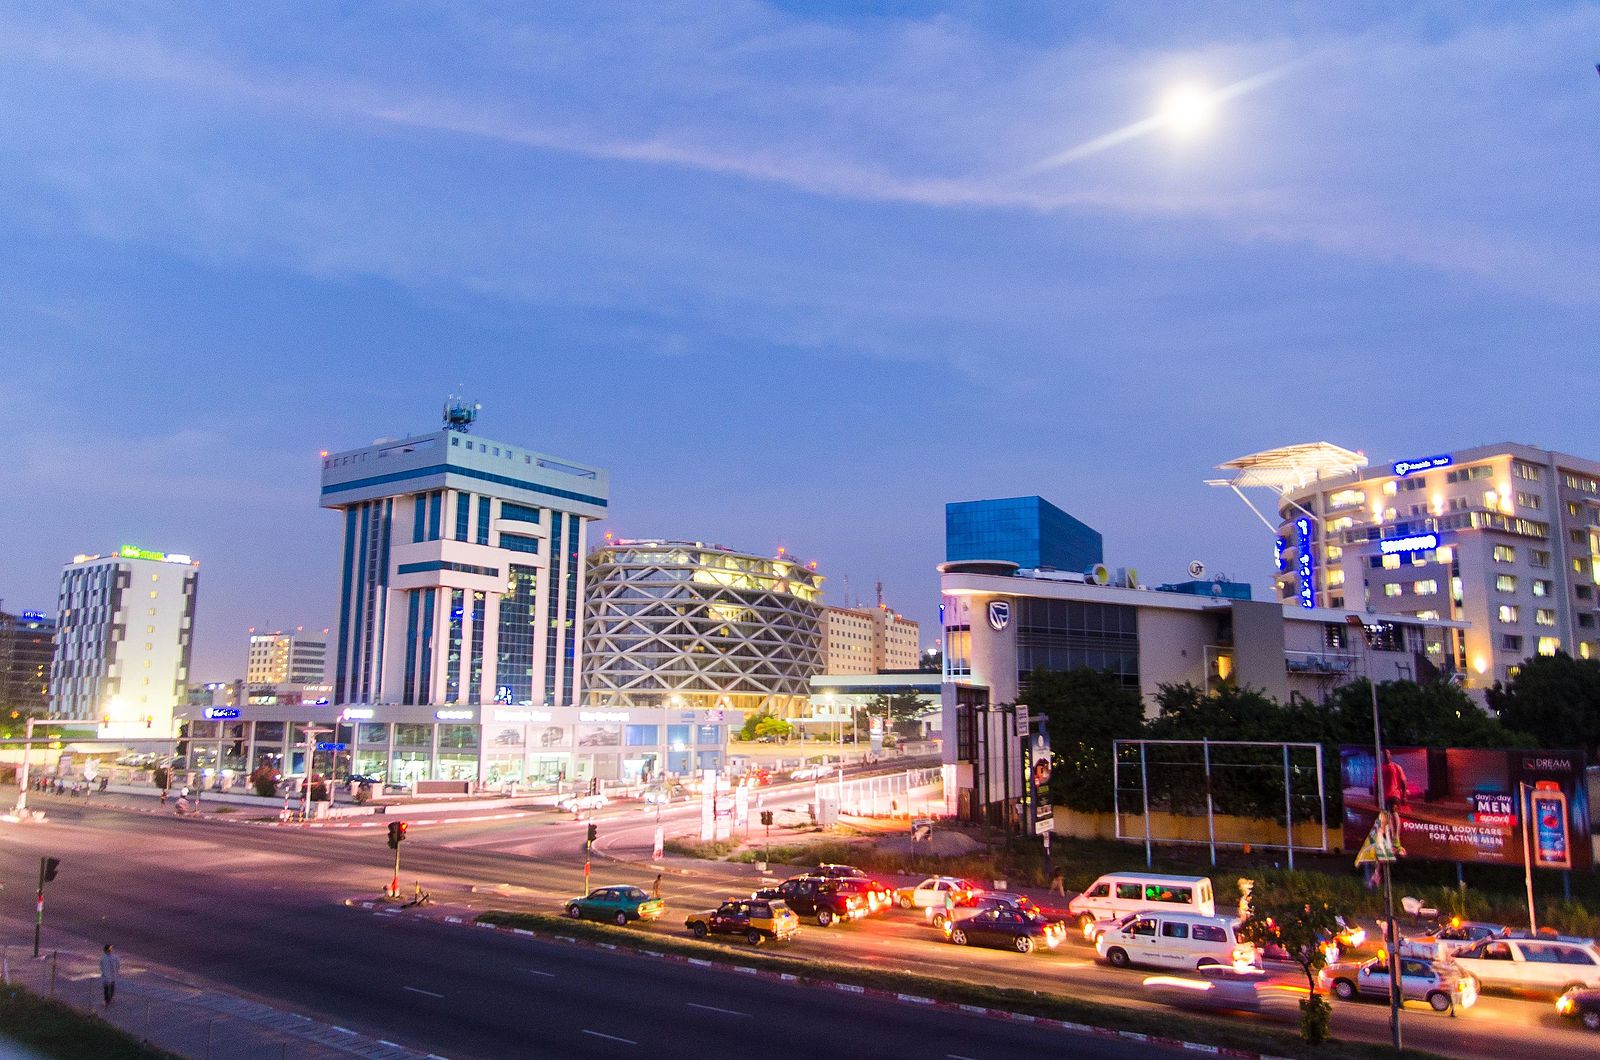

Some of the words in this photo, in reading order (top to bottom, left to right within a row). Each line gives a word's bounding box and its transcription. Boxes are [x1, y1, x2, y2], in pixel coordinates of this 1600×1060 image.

[1536, 758, 1570, 767] DREAM
[1478, 802, 1511, 813] MEN
[1479, 814, 1509, 824] sport
[1403, 822, 1450, 832] POWERFUL
[1452, 825, 1476, 834] BODY
[1479, 827, 1502, 836] CARE
[1429, 833, 1447, 841] FOR
[1448, 834, 1478, 843] ACTIVE
[1481, 836, 1503, 845] MEN
